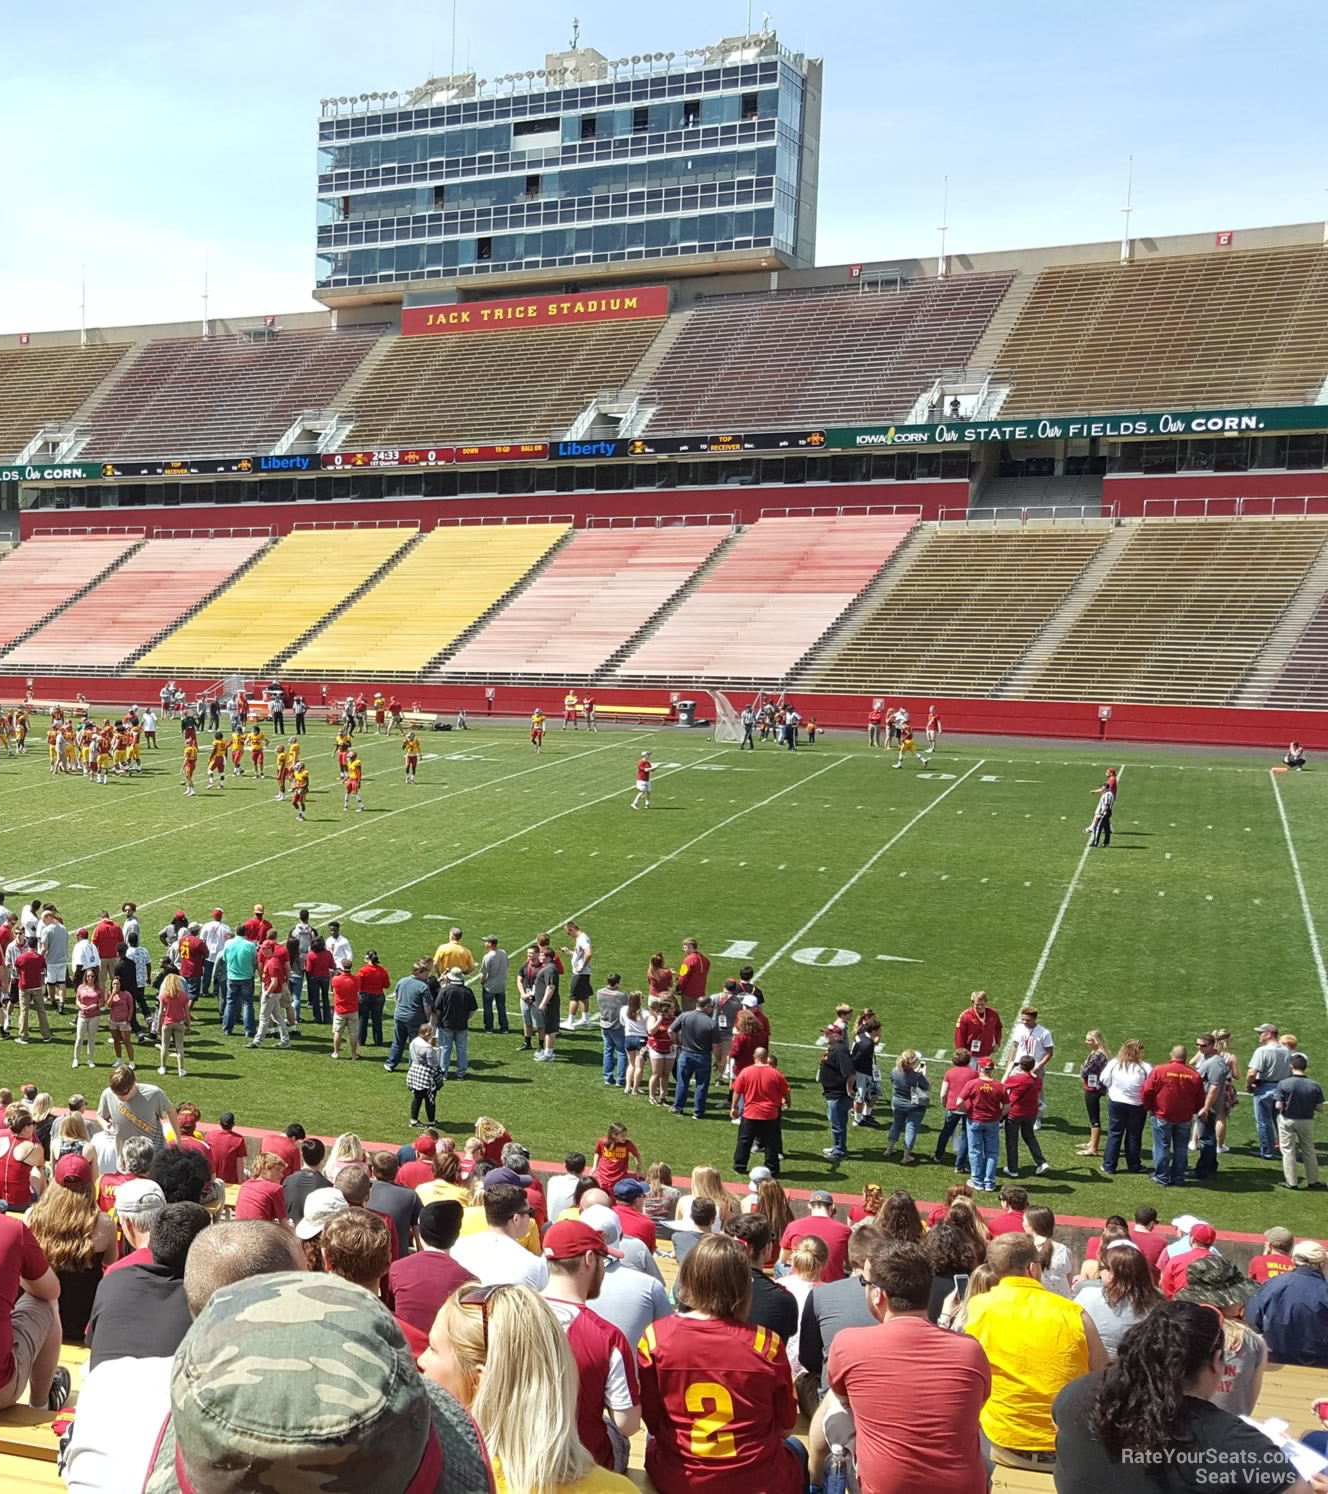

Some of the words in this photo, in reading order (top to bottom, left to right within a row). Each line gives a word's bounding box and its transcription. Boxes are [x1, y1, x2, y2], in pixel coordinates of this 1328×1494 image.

[1220, 236, 1228, 245] C
[852, 268, 860, 276] D
[427, 312, 470, 326] JACK
[481, 305, 537, 321] TRICE
[548, 297, 638, 316] STADIUM
[856, 434, 885, 444] IOWA
[894, 433, 928, 443] CORN
[935, 425, 958, 442] Our
[964, 427, 1033, 440] STATE.
[1038, 420, 1062, 438] Our
[1069, 421, 1154, 437] FIELDS.
[1159, 414, 1185, 433] Our
[1191, 416, 1265, 431] CORN.
[559, 441, 616, 457] Liberty
[710, 443, 741, 451] RECEIVER
[334, 455, 342, 466] 0
[372, 451, 400, 461] 24:33
[428, 451, 436, 460] 0
[260, 456, 310, 471] Liberty
[44, 469, 87, 479] CORN.
[180, 946, 190, 958] 23
[685, 1382, 737, 1456] 2
